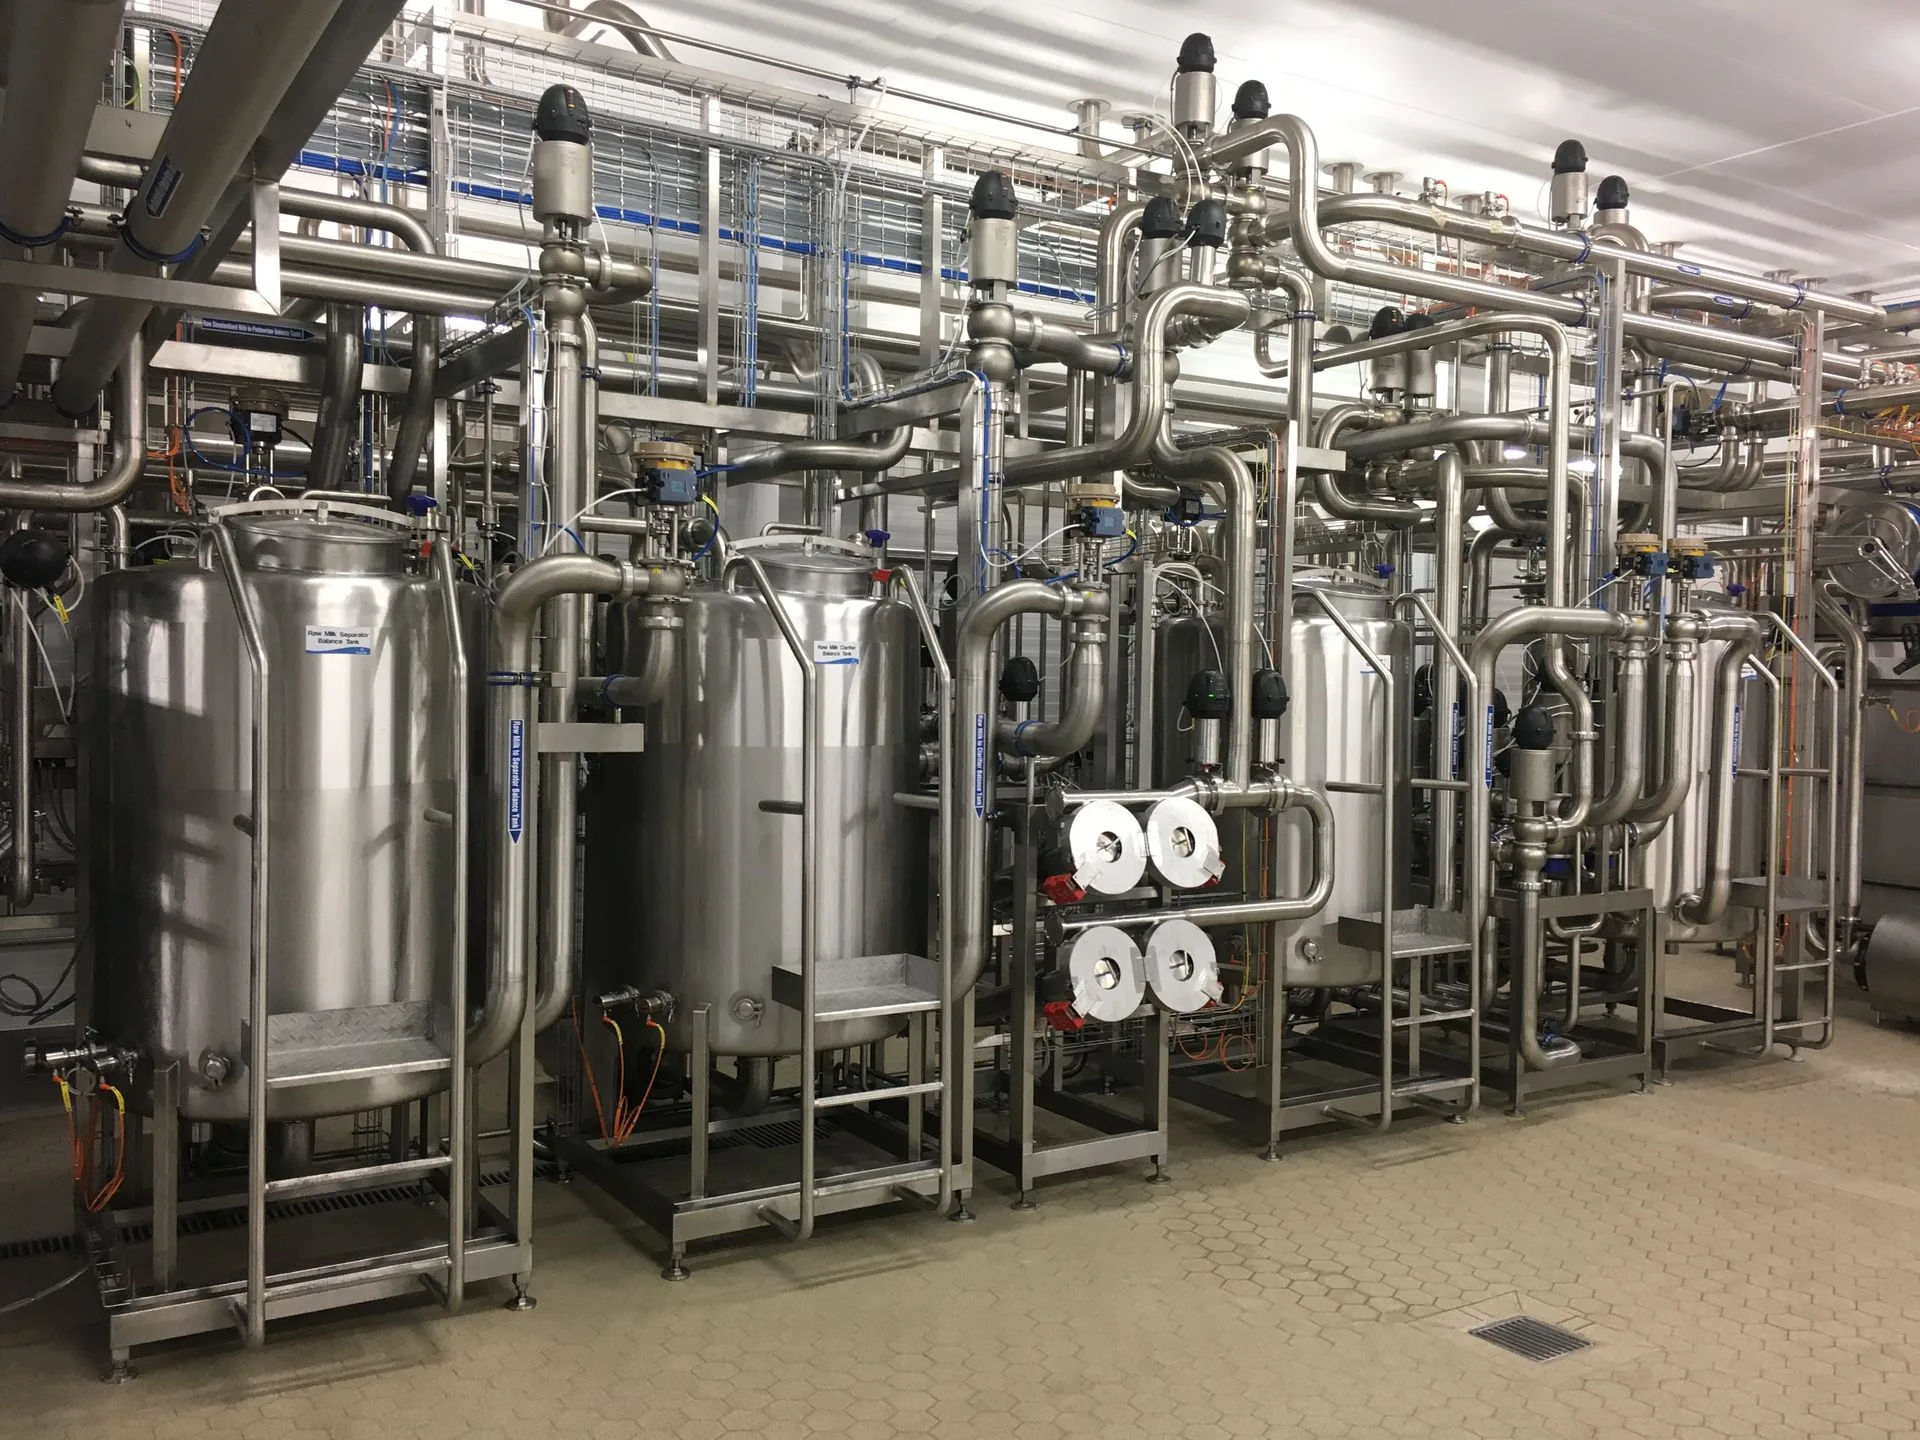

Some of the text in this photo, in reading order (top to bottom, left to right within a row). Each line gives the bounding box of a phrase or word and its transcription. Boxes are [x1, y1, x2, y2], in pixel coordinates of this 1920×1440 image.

[339, 631, 369, 639] Separator
[512, 720, 521, 734] Raw
[512, 735, 521, 749] Milk
[511, 757, 520, 787] Separator
[511, 788, 520, 813] Balance
[511, 814, 520, 829] Tank
